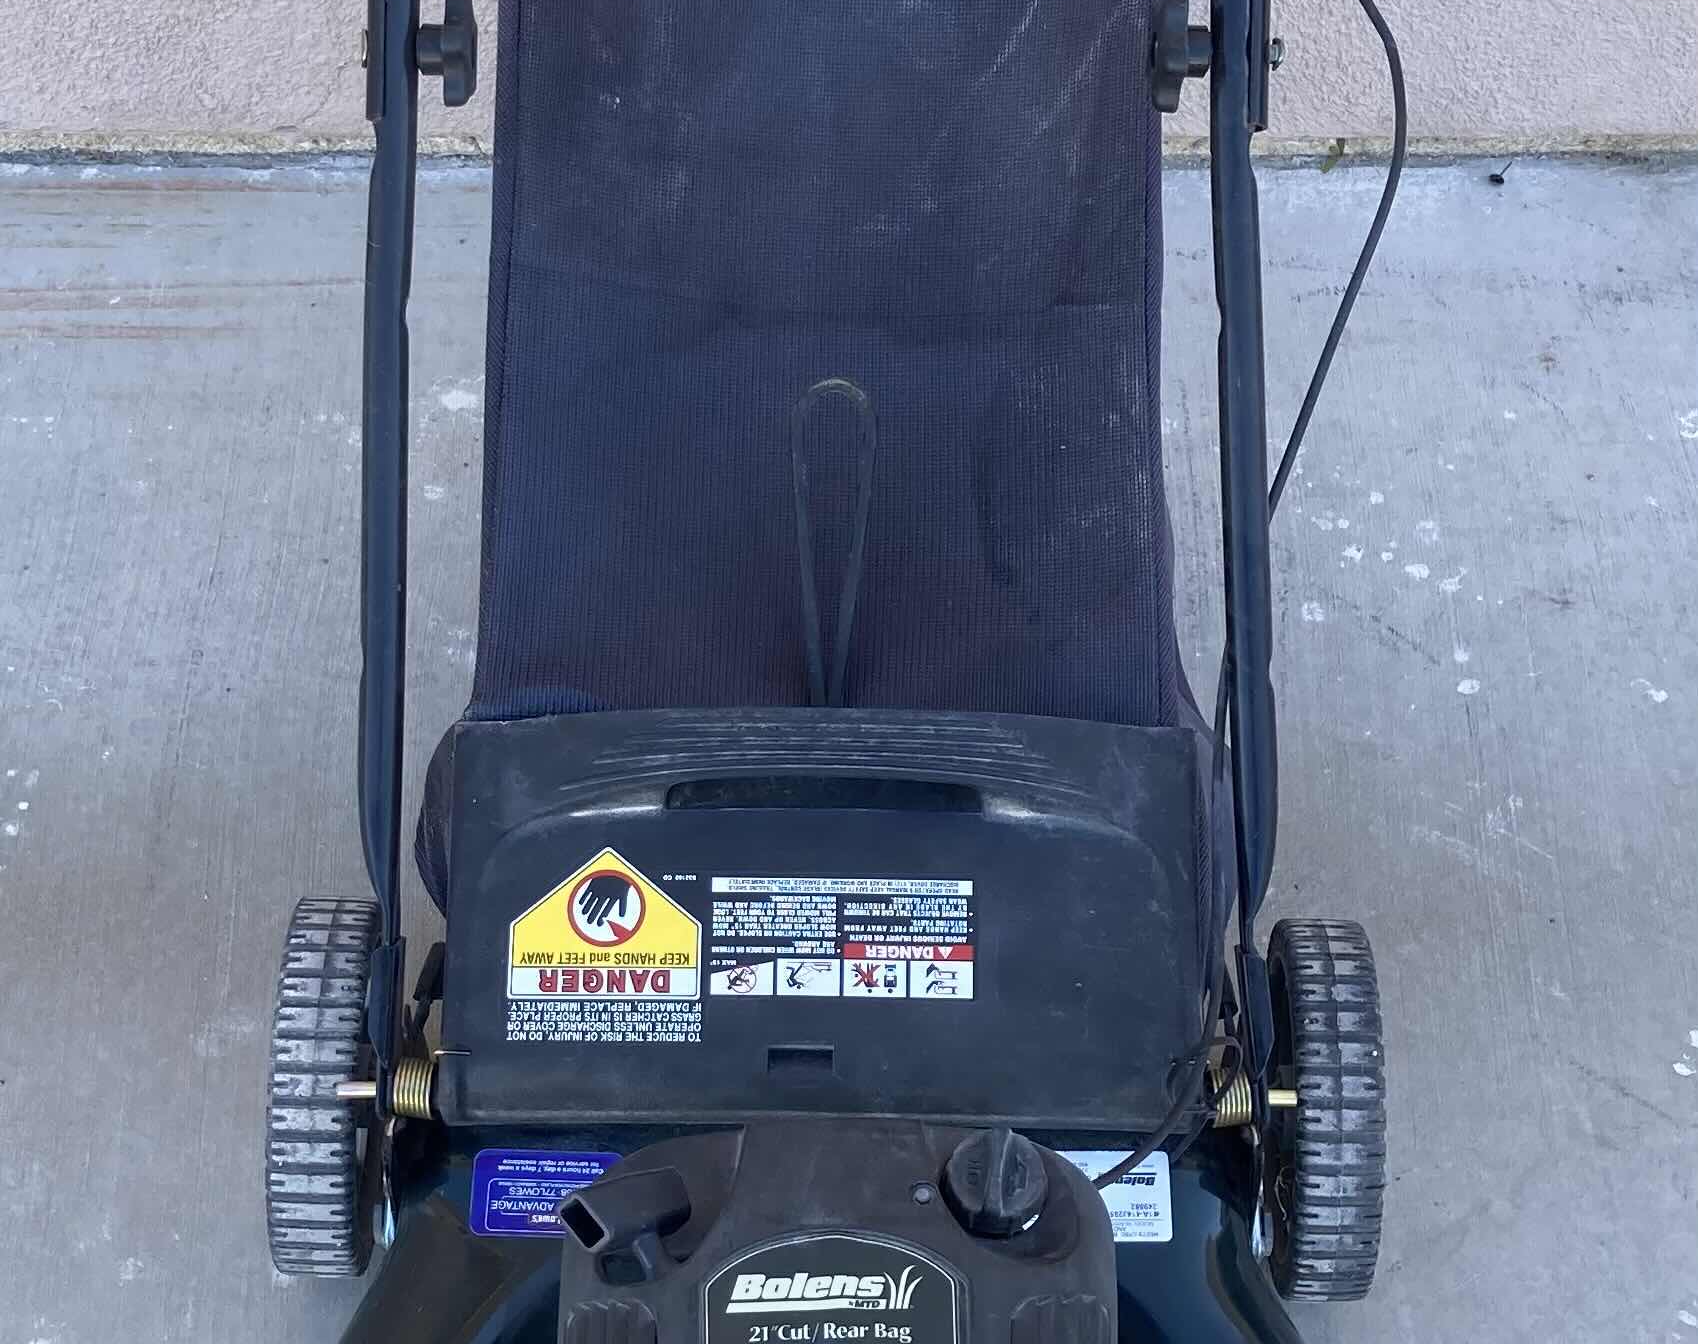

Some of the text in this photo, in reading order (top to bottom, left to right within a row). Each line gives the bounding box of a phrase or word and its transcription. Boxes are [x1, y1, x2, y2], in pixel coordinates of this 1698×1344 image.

[865, 945, 934, 959] DANGER
[520, 952, 690, 964] KEEP HANDS and FEET AWAY
[538, 969, 671, 993] DANGER
[584, 1002, 631, 1011] REPLACE
[635, 1001, 689, 1011] DAMAGED,
[692, 1002, 701, 1011] IF
[507, 1012, 701, 1021] GRASS CATCHER IS IN ITS PROPER PLACE.
[507, 1022, 701, 1031] OPERATE UNLESS DISCHARGE COVER OR
[506, 1030, 701, 1042] TO REDUCE THE RISK OF INJURY, DO NOT
[490, 1200, 554, 1211] ADVANTAGE
[730, 1272, 886, 1300] Bolens
[854, 1299, 881, 1308] MTD
[824, 1322, 868, 1338] Rear
[874, 1323, 912, 1343] Bag
